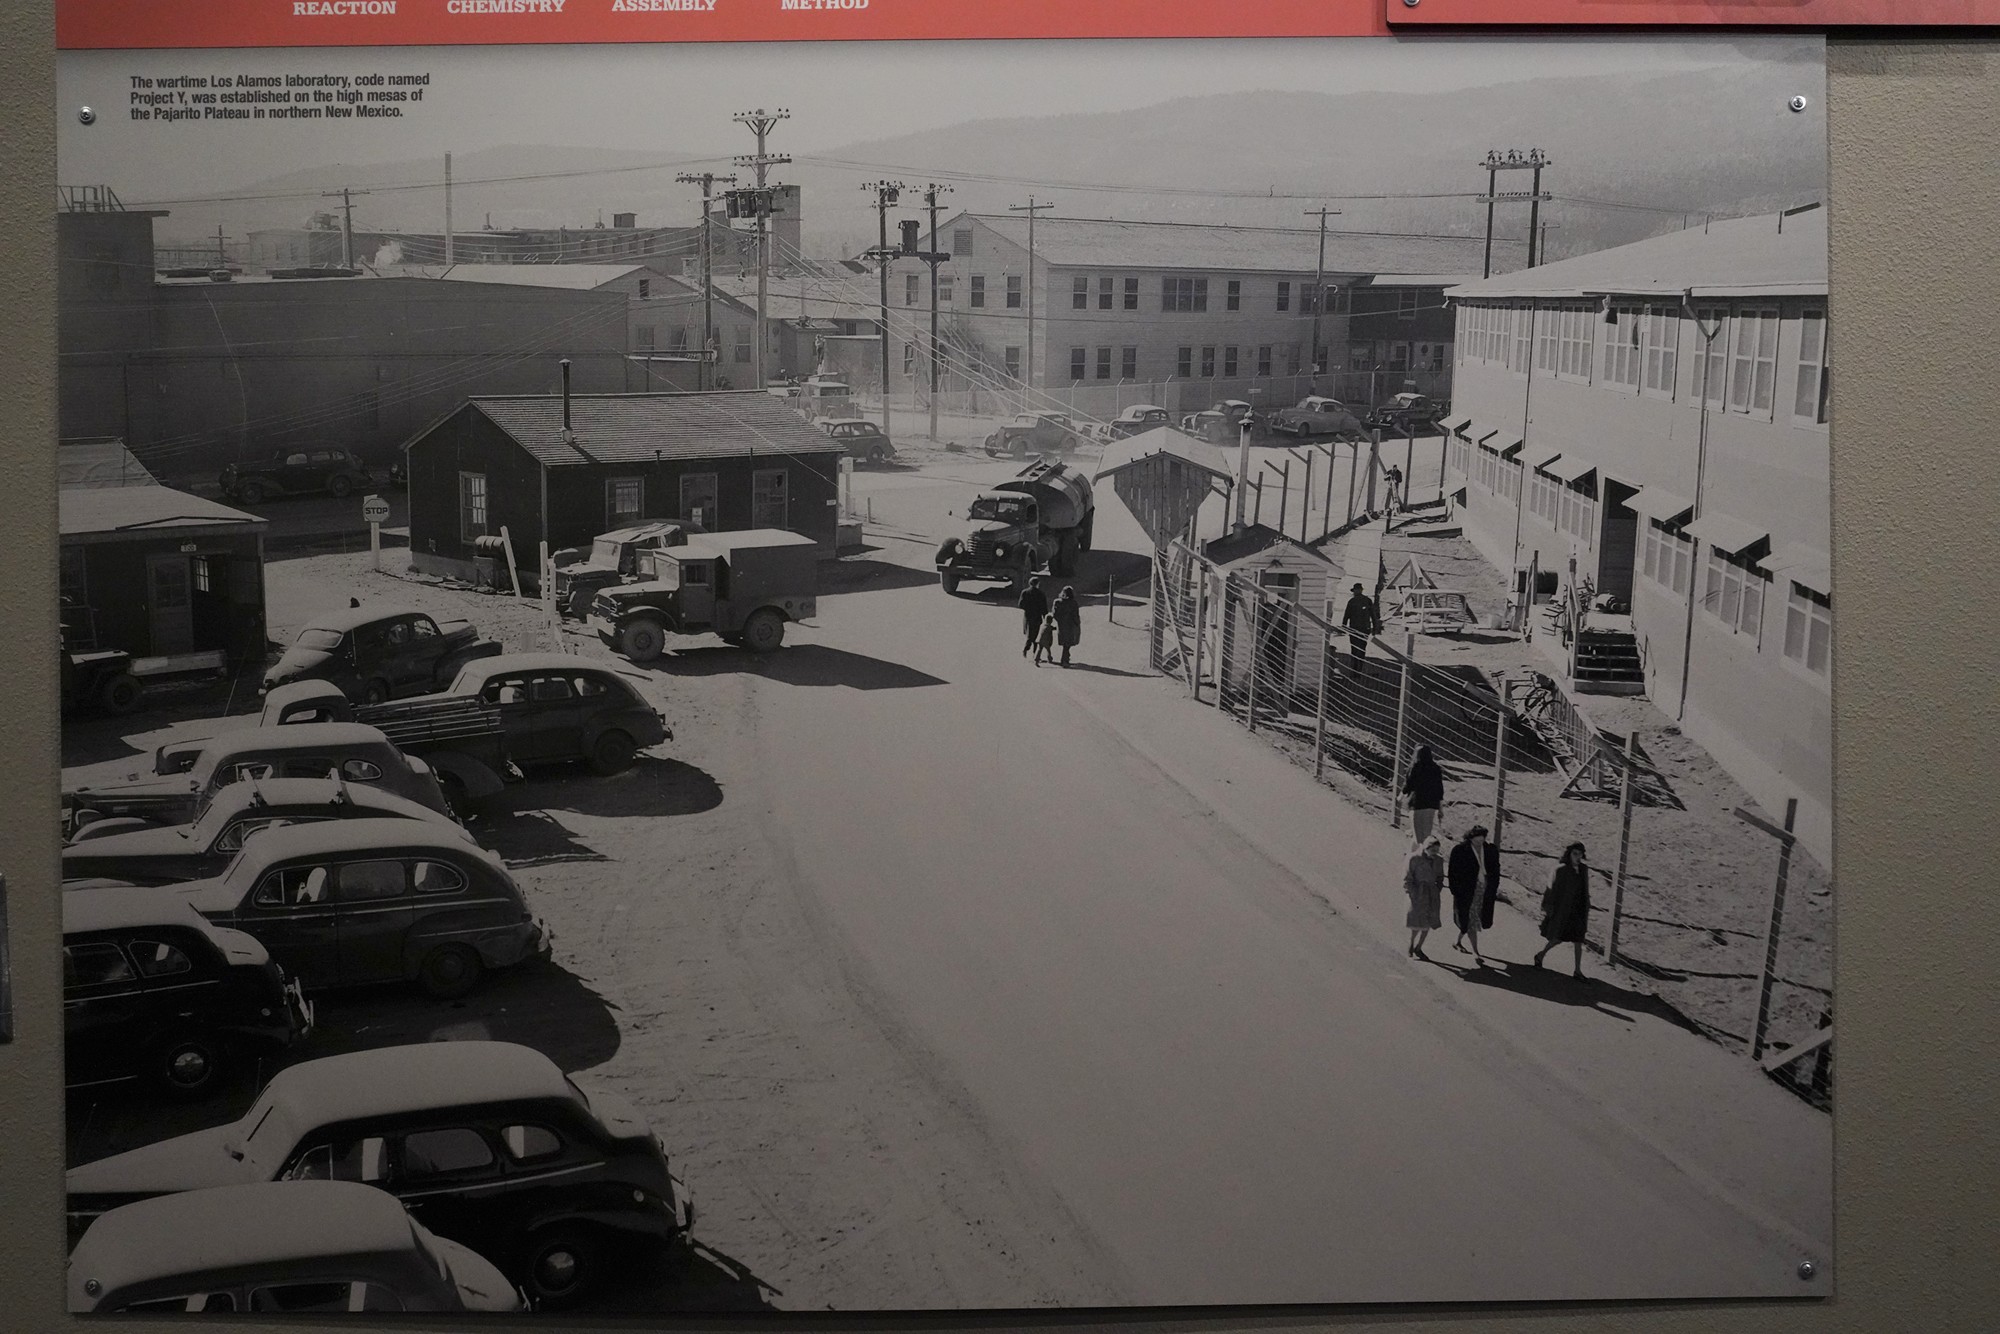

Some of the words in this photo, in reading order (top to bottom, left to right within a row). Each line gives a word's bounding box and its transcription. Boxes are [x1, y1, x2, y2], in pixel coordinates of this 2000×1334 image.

[293, 1, 396, 16] REACTION
[447, 0, 566, 14] CHEMISTRY
[611, 0, 718, 12] ASSEMBLY
[780, 0, 869, 10] METHOD
[130, 76, 153, 89] The
[156, 75, 207, 89] wartime
[211, 75, 232, 88] Los
[236, 75, 282, 88] Alamos
[285, 74, 351, 90] laboratory,
[354, 73, 384, 87] code
[388, 73, 430, 86] named
[130, 92, 174, 107] Project
[177, 92, 188, 107] Y,
[192, 93, 216, 104] was
[220, 90, 291, 104] established
[294, 92, 310, 103] on
[313, 90, 333, 102] the
[336, 88, 364, 105] high
[367, 90, 407, 102] mesas
[411, 89, 424, 102] of
[130, 107, 150, 120] the
[154, 107, 201, 123] Pajarito
[204, 106, 250, 119] Plateau
[254, 106, 265, 119] in
[269, 105, 322, 119] northern
[325, 105, 353, 118] New
[356, 104, 403, 118] Mexico.
[365, 507, 388, 515] STOP
